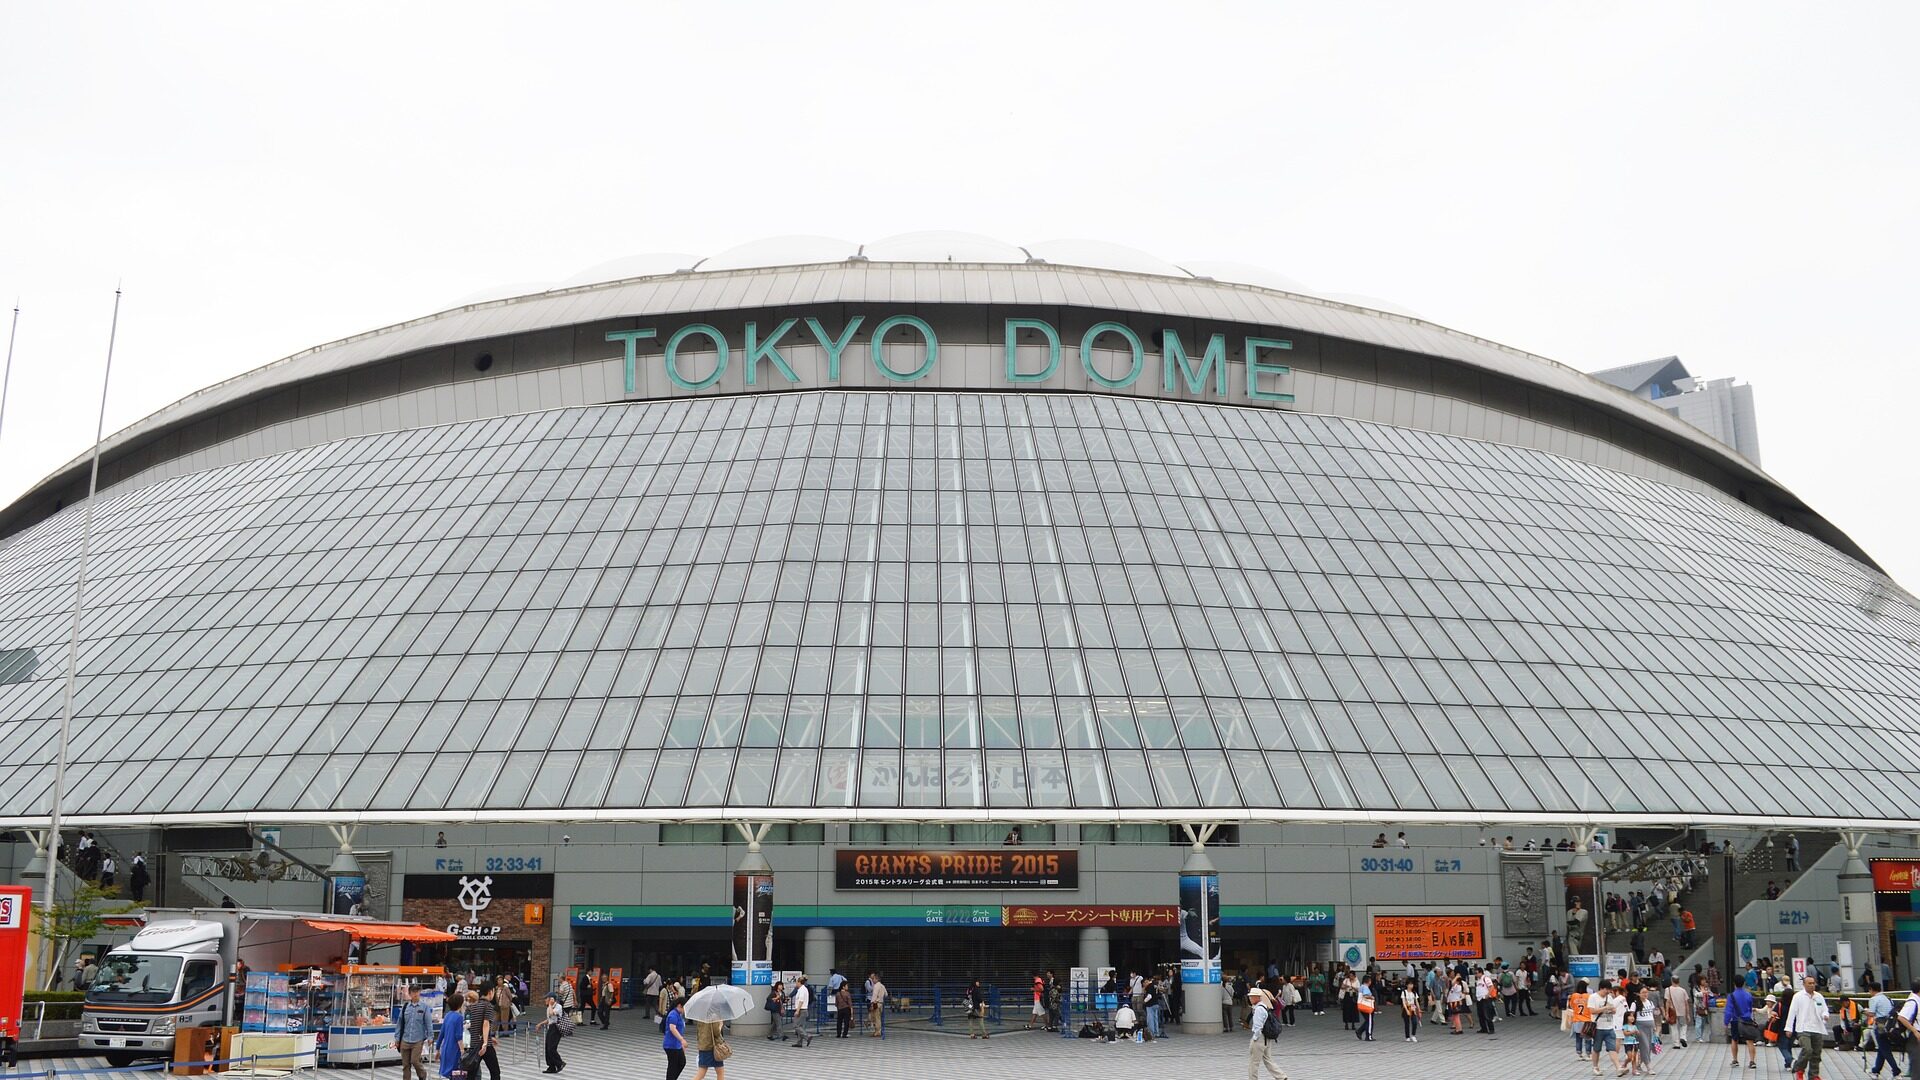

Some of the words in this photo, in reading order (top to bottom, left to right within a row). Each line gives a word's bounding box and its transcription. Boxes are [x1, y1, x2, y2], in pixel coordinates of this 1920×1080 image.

[605, 314, 939, 394] TOKYO
[1005, 317, 1296, 404] DOME
[855, 854, 932, 875] GIANTS
[940, 854, 1003, 875] PRIDE
[1011, 854, 1059, 875] 2015
[586, 911, 600, 922] 23
[1042, 908, 1175, 922] シーズンシート専用ゲート
[1308, 910, 1320, 921] 21
[1790, 910, 1801, 925] 21
[1577, 1004, 1585, 1016] 7
